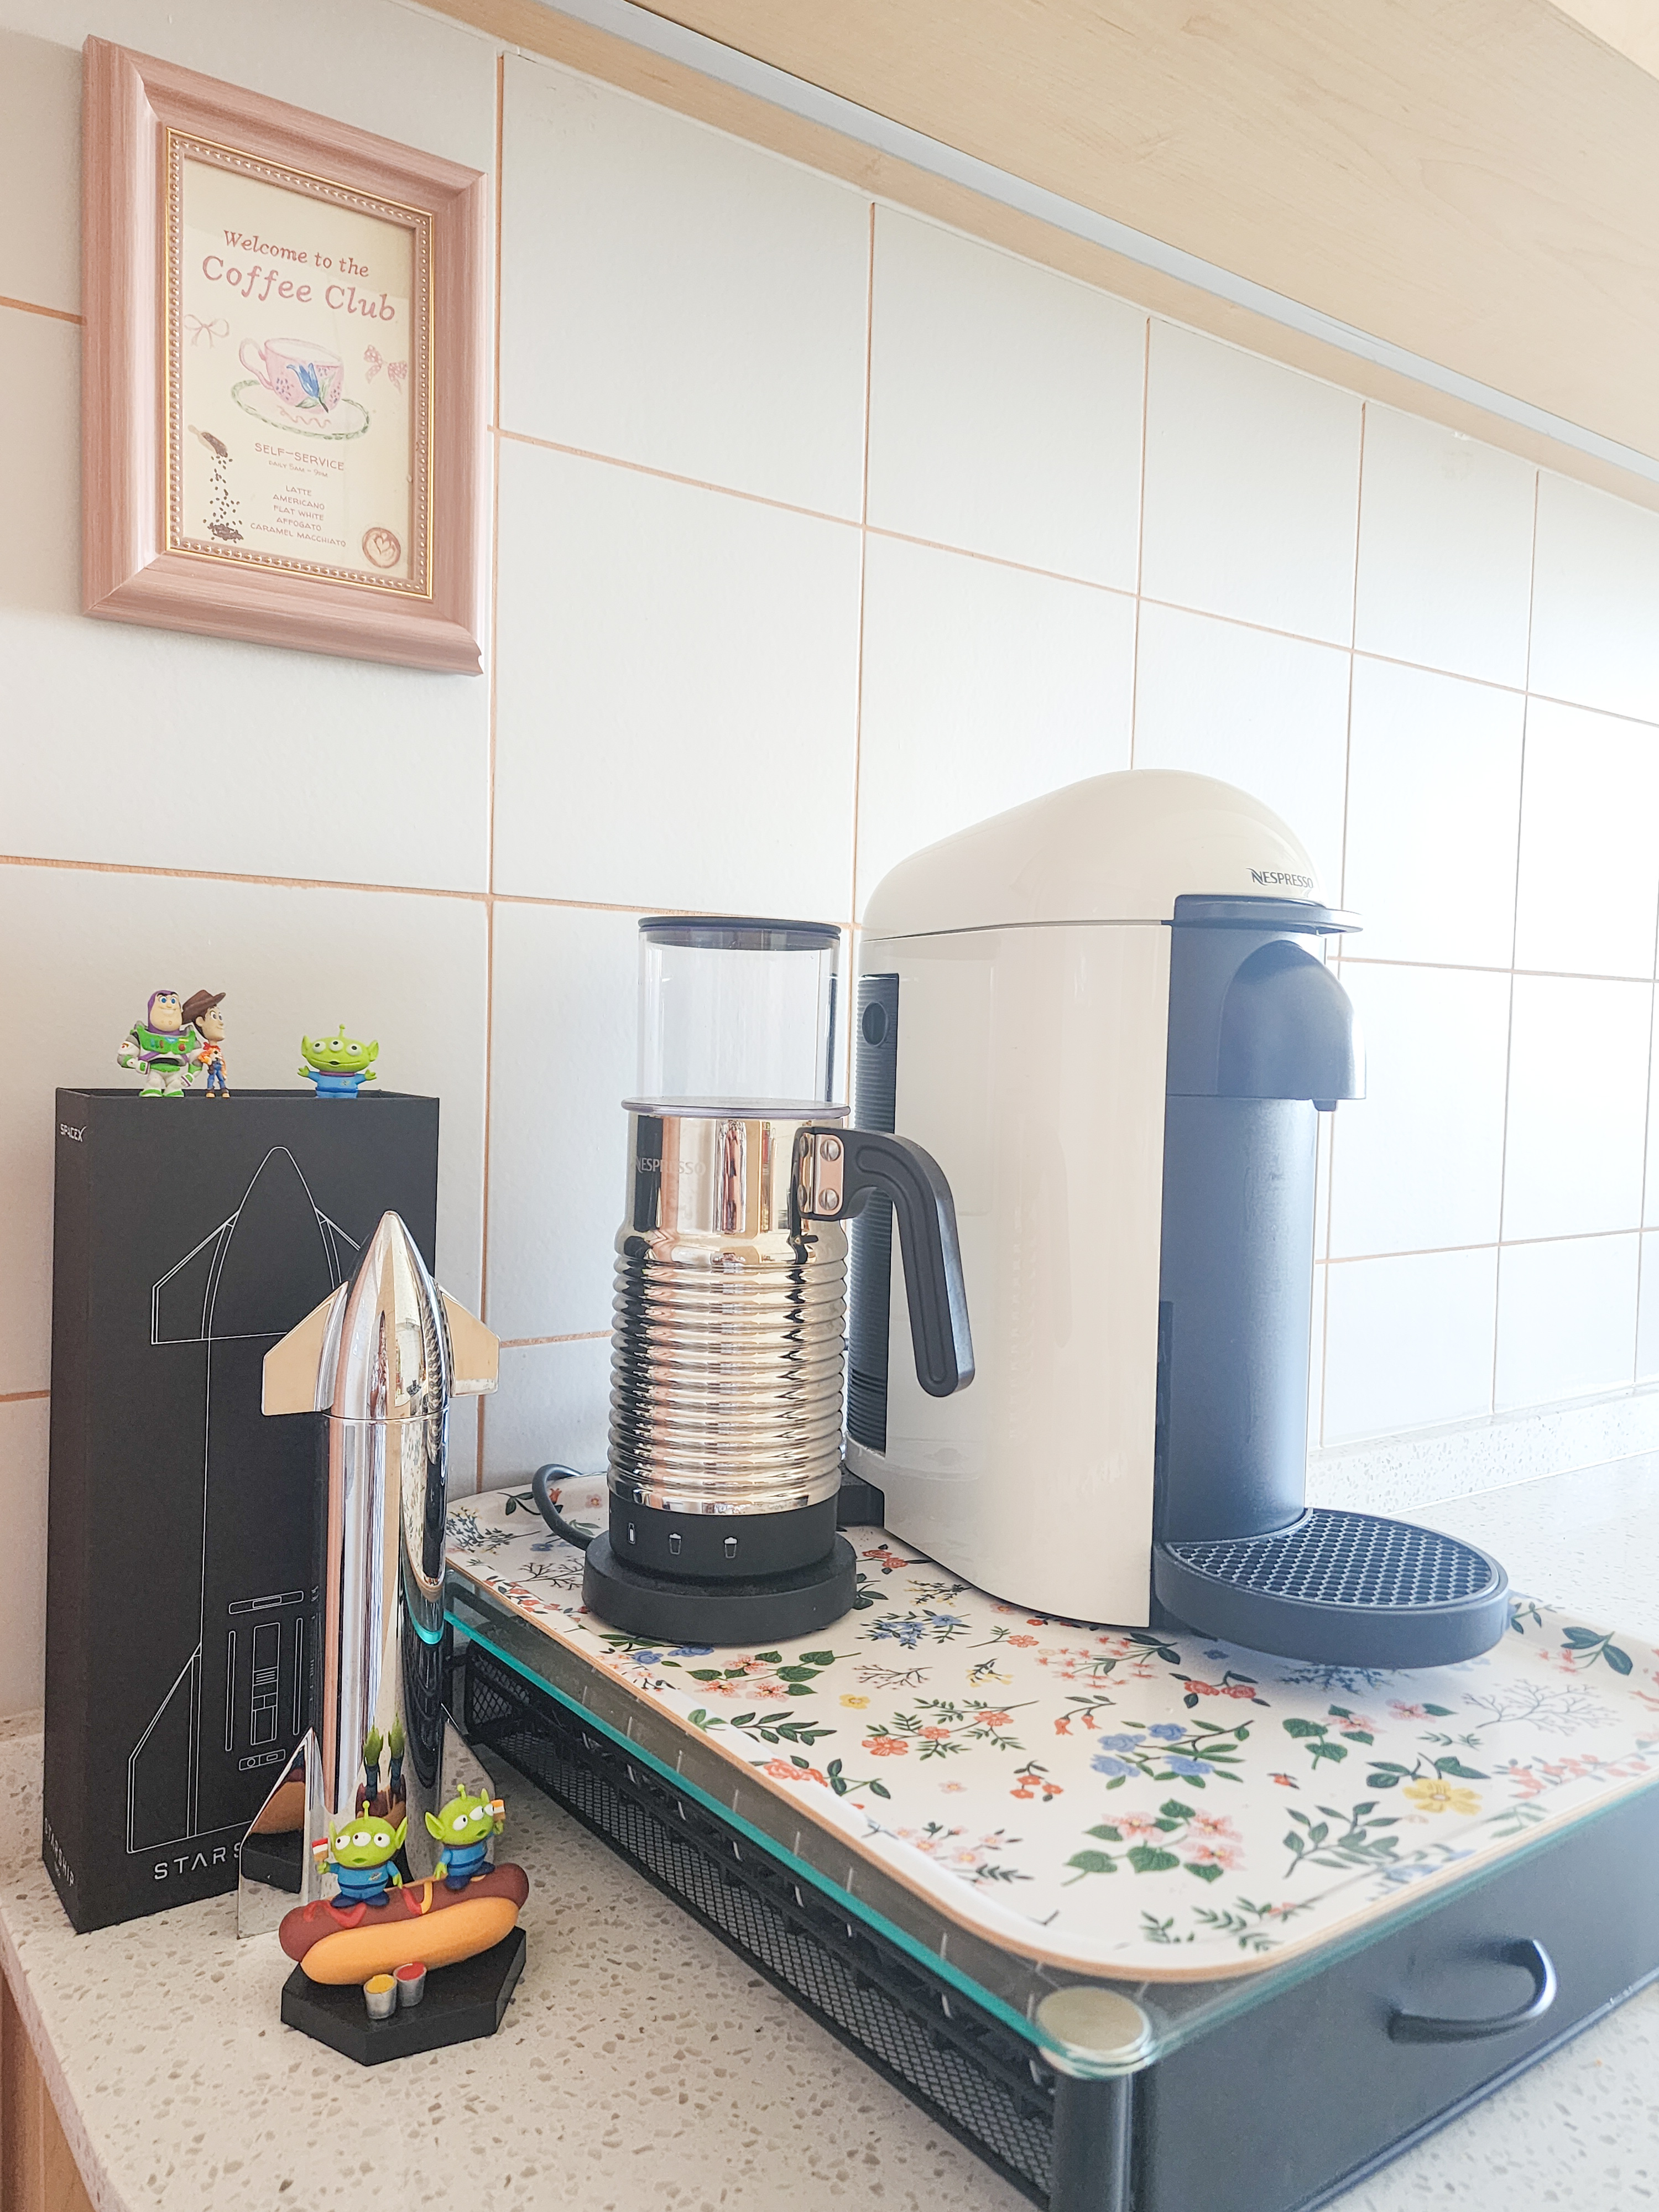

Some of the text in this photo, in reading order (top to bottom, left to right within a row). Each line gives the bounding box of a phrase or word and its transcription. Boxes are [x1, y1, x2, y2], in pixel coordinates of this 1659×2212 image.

[223, 229, 369, 276] Welcome to the
[202, 255, 395, 321] Coffee Club
[254, 442, 343, 470] SELF-SERVICE
[268, 460, 286, 468] DAILY
[286, 485, 311, 495] LATTE
[273, 494, 324, 510] AMERICANO
[273, 504, 323, 520] FLAT WHITE
[276, 517, 321, 531] AFFOGATO
[250, 523, 346, 547] CARAMEL MACCHIATO
[1245, 868, 1313, 888] NESPRESSO
[60, 1124, 87, 1142] SPACEX
[636, 1156, 706, 1176] NESPSSO
